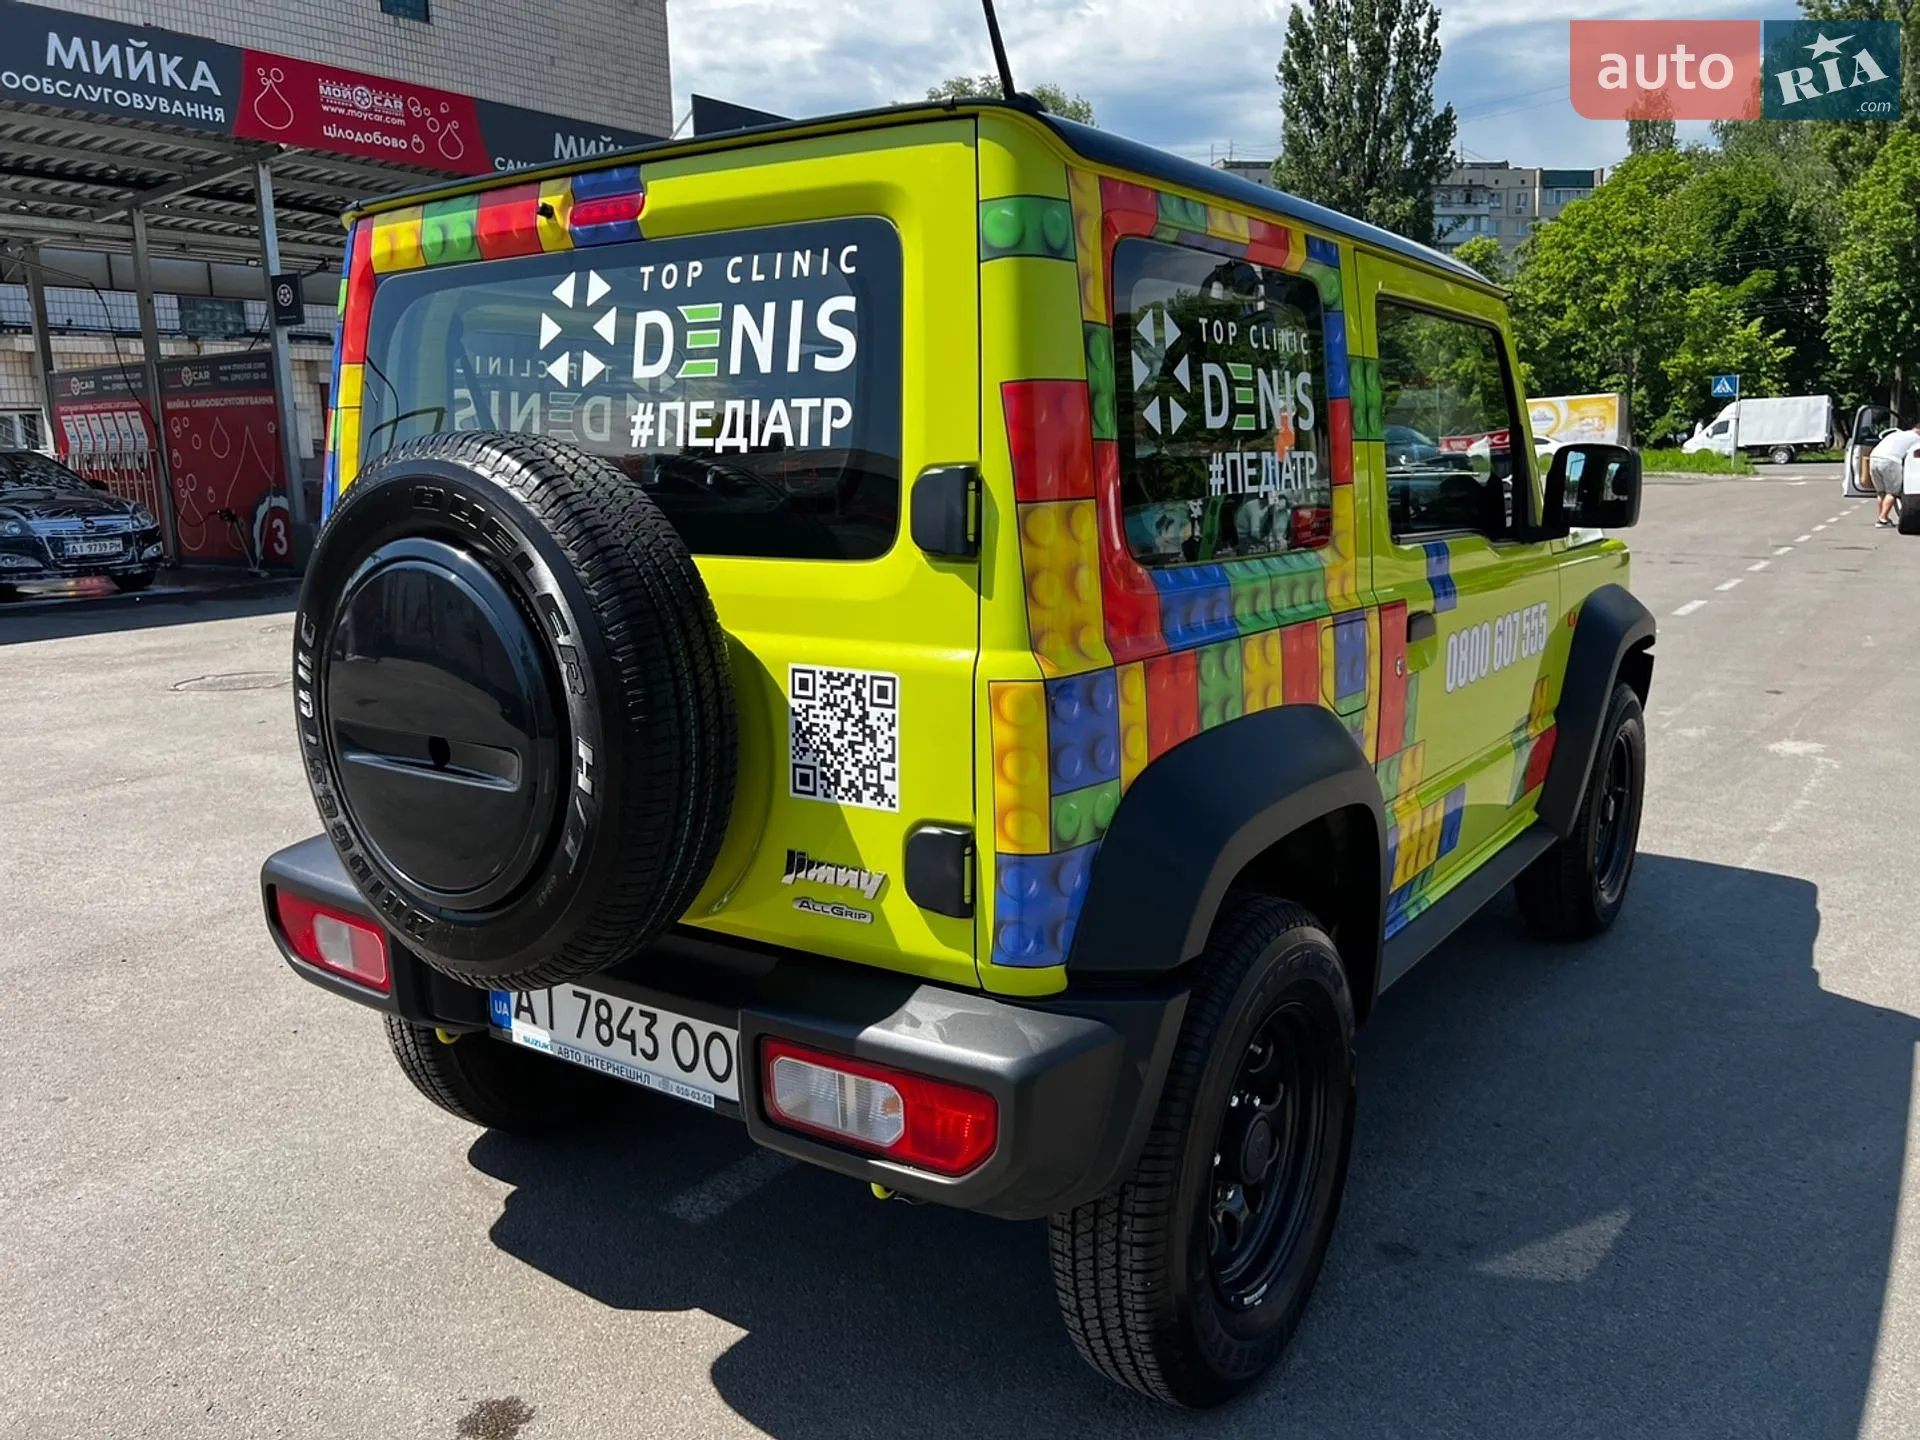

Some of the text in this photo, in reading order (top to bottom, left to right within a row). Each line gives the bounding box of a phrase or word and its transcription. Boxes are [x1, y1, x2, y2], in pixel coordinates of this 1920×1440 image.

[46, 31, 222, 96] МИЙКА
[1, 71, 225, 123] ООБСЛУГОВУВАННЯ
[373, 97, 404, 110] CAR
[554, 132, 623, 160] МИЙ
[640, 245, 858, 291] TOP CLINIC
[632, 295, 858, 379] DENIS
[1199, 317, 1309, 355] TOP CLINIC
[1201, 362, 1315, 431] DENIS
[630, 397, 853, 454] #ПЕДІАТР
[1209, 452, 1318, 498] #ПЕДІАТР
[271, 518, 288, 554] 3
[1445, 601, 1548, 694] 0800 607 555
[781, 849, 888, 900] Jimny
[494, 999, 510, 1017] UA
[572, 989, 659, 1062] 7843
[556, 1045, 582, 1063] АВТО
